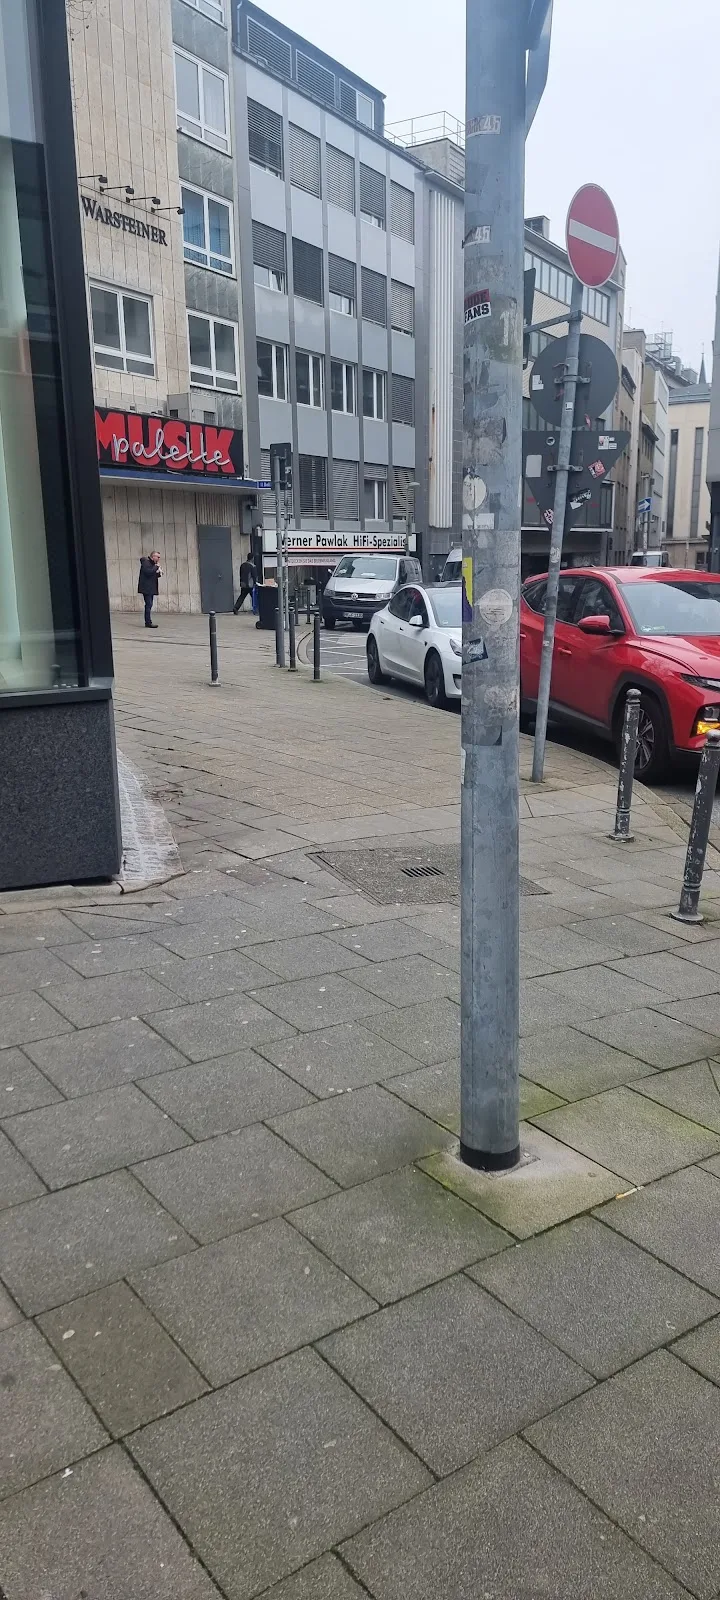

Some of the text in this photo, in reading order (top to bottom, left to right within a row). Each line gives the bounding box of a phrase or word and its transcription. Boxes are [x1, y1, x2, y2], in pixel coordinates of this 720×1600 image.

[81, 195, 168, 247] WARSTEINER
[95, 409, 235, 474] MUSIK
[113, 428, 230, 466] palette
[316, 535, 348, 547] Pawlak
[353, 535, 407, 549] HiFi-Spezialis
